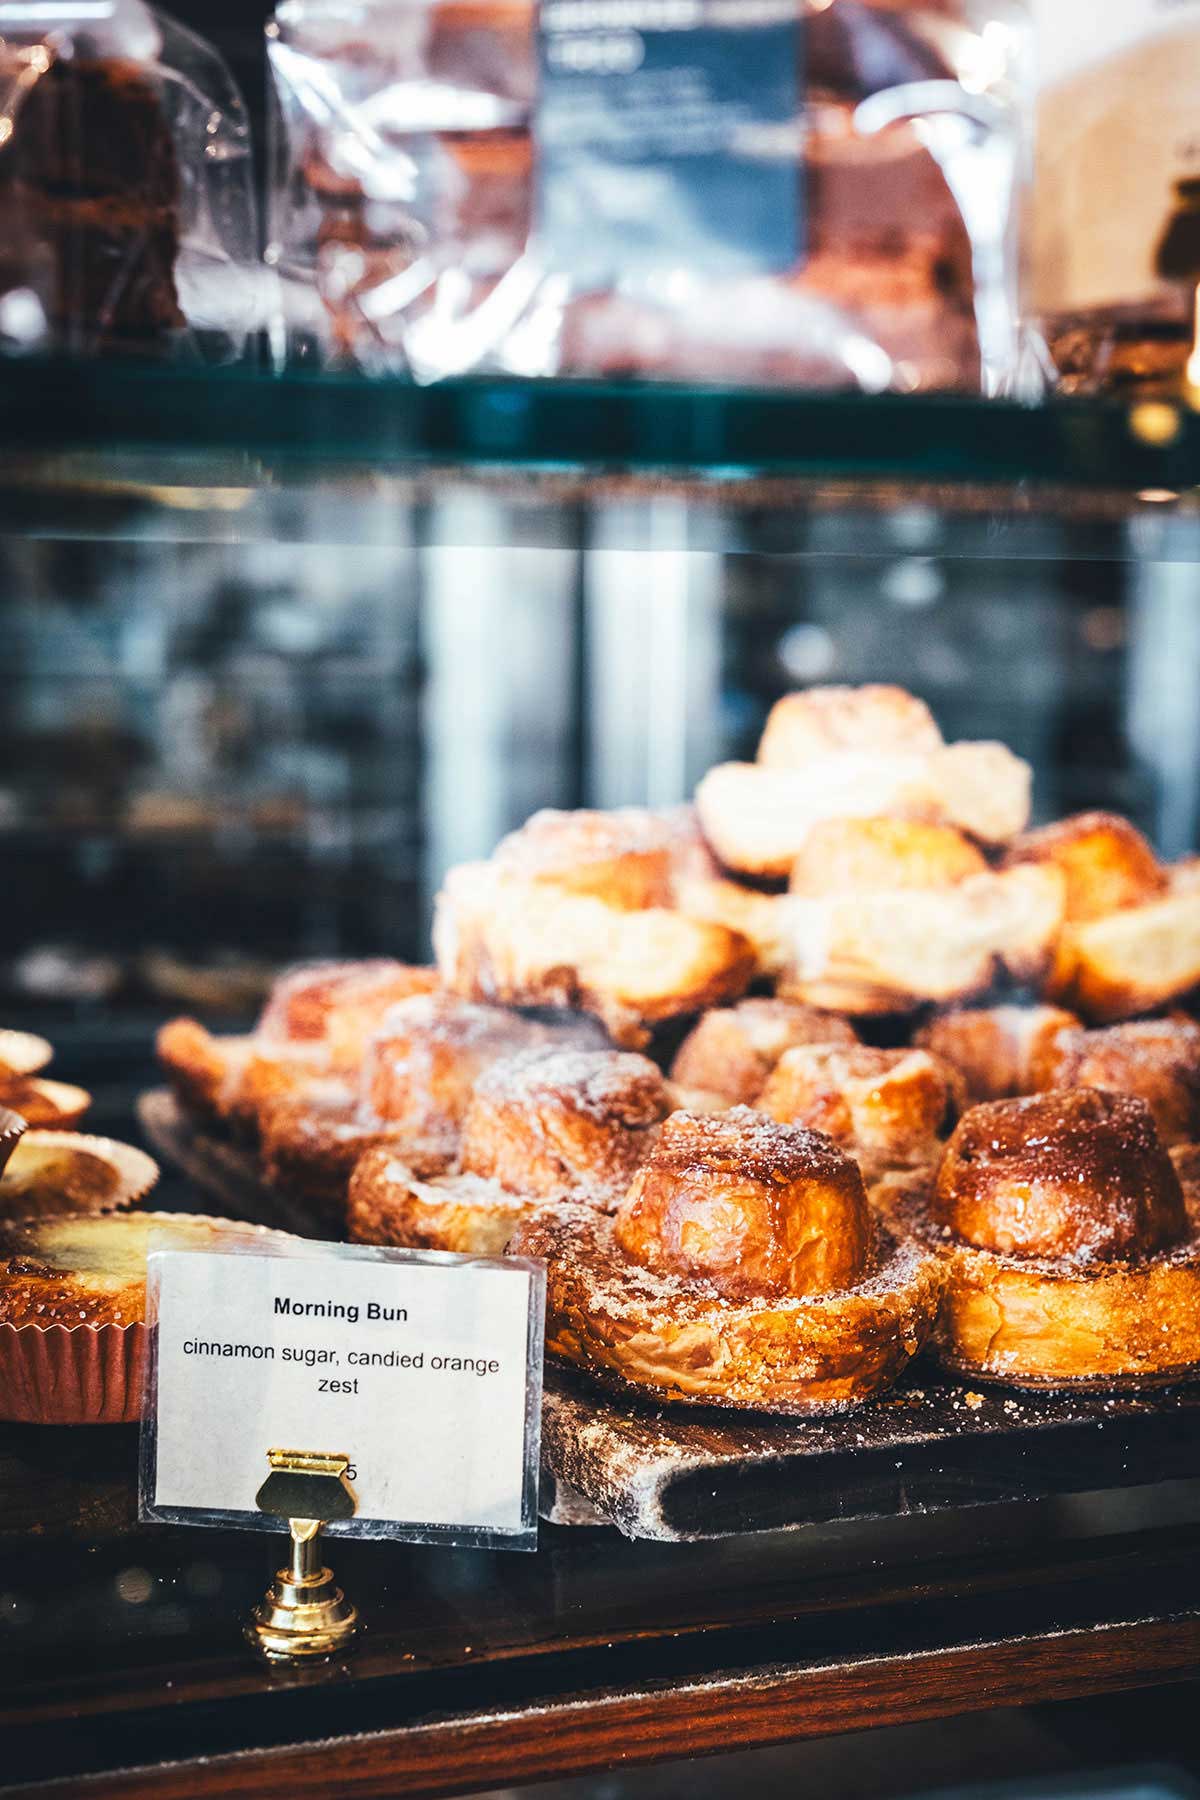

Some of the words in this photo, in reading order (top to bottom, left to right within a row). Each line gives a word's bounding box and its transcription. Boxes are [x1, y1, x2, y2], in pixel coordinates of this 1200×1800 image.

[274, 1296, 359, 1323] Morning
[366, 1302, 408, 1322] Bun
[183, 1337, 275, 1360] cinnamon
[281, 1346, 340, 1367] sugar,
[347, 1350, 424, 1369] candied
[430, 1356, 500, 1376] orange
[317, 1377, 359, 1395] zest
